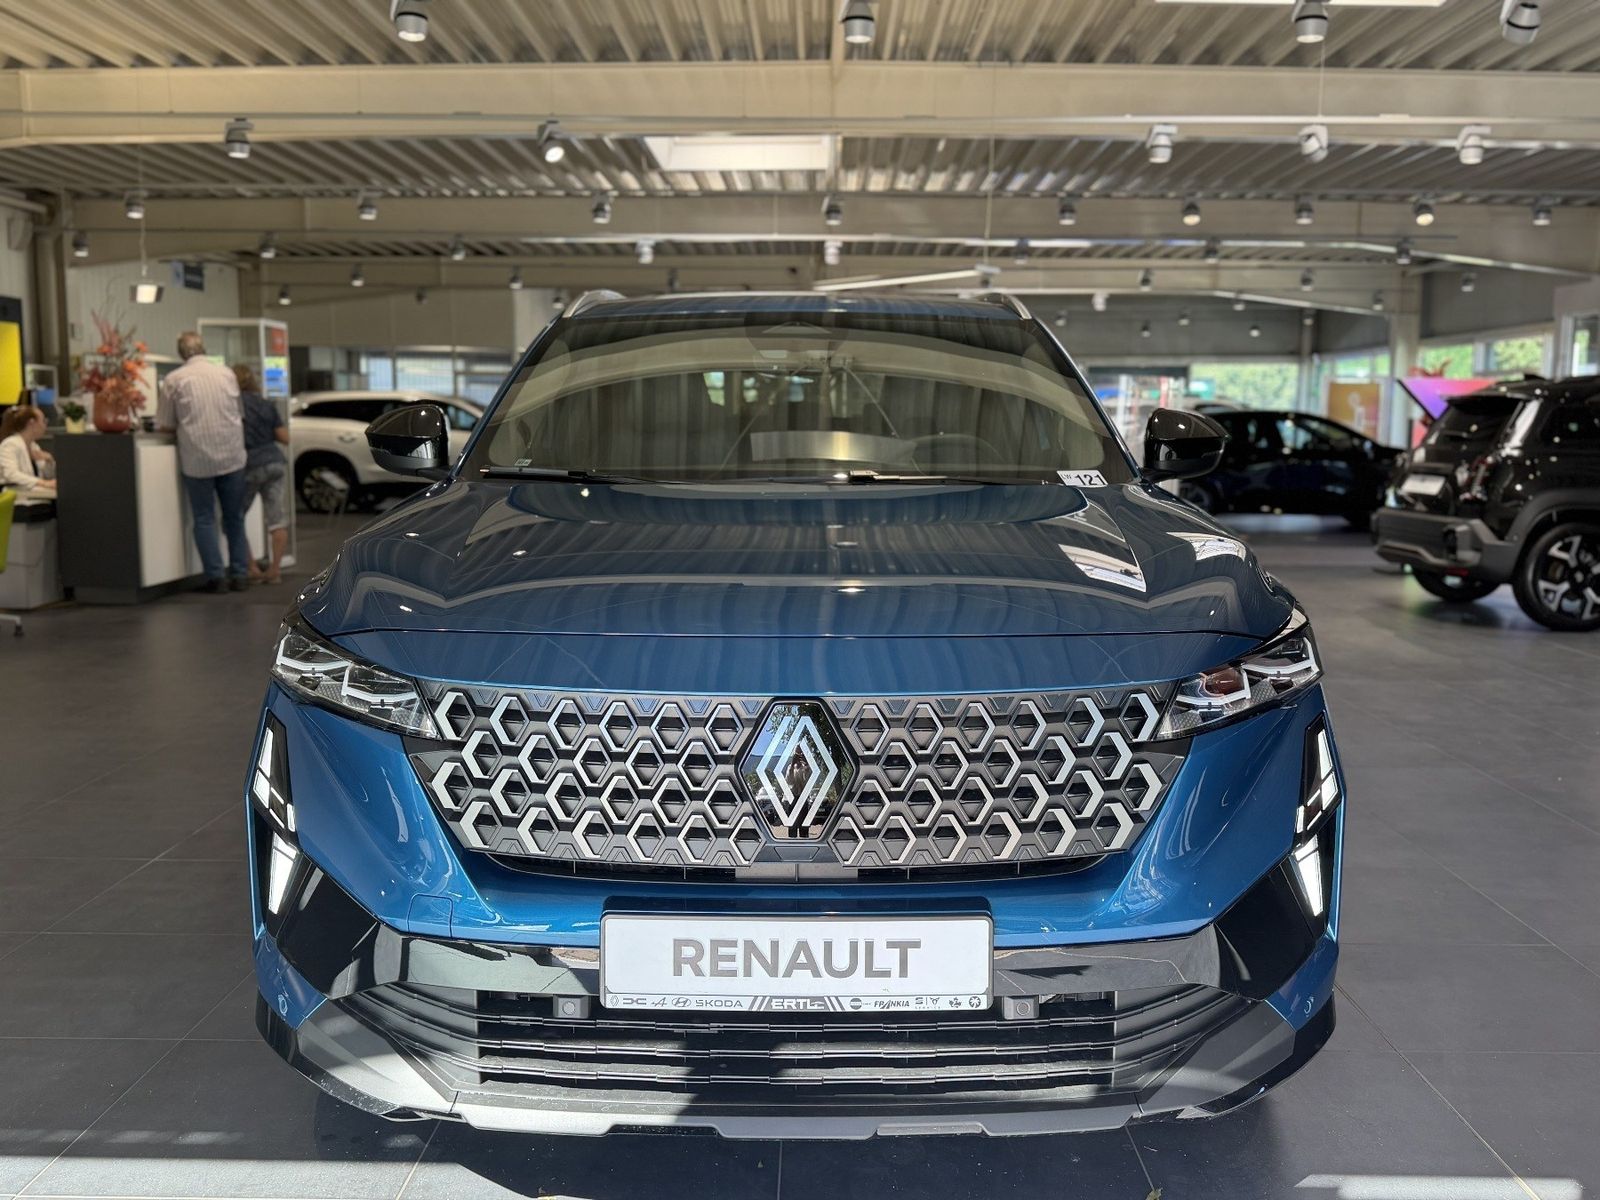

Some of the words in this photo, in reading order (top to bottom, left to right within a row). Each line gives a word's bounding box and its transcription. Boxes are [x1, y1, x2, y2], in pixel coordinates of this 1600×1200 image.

[1074, 474, 1106, 485] 121
[673, 938, 922, 978] RENAULT
[770, 998, 824, 1010] ERTL
